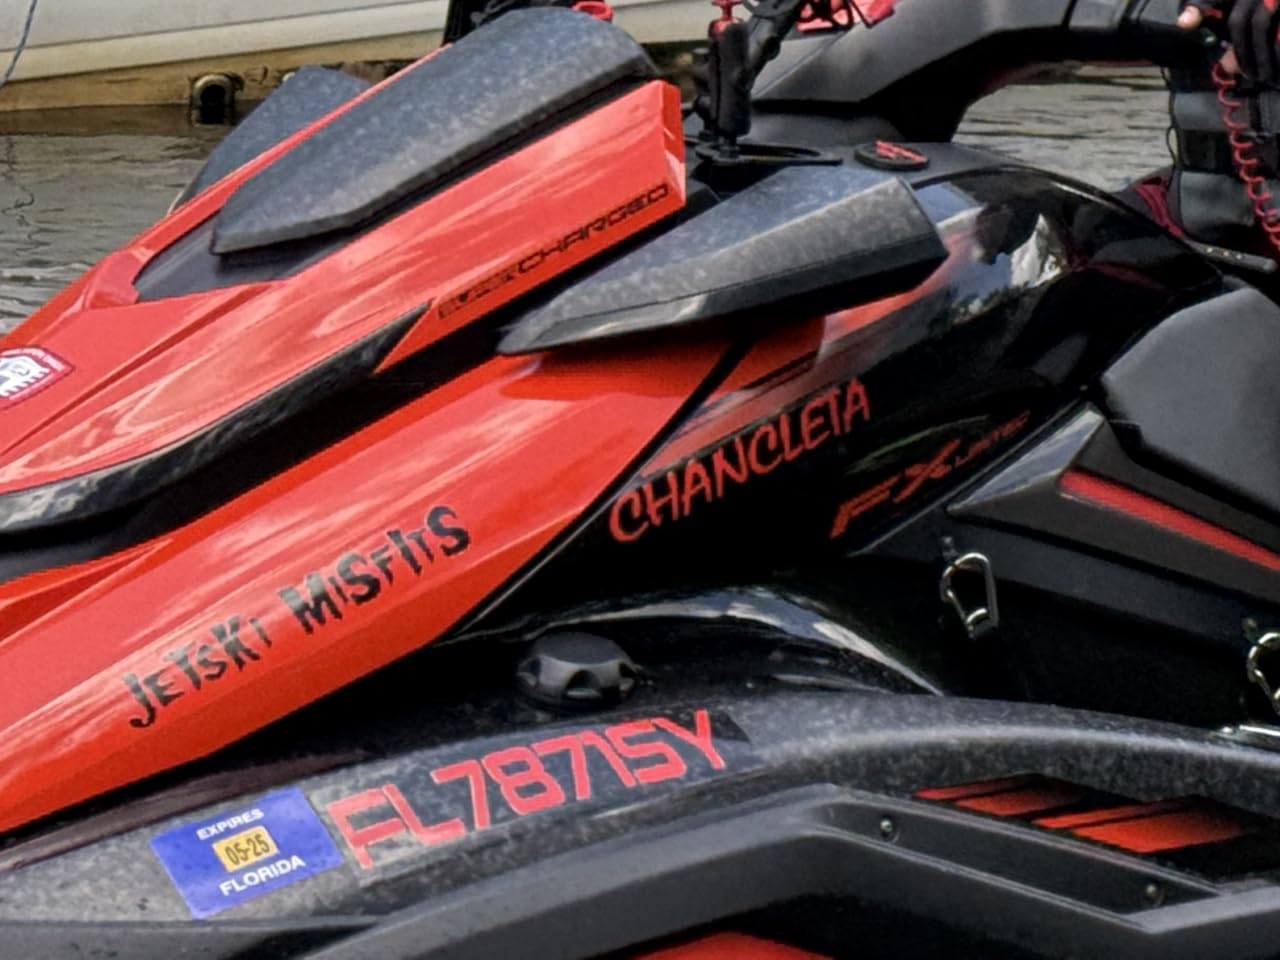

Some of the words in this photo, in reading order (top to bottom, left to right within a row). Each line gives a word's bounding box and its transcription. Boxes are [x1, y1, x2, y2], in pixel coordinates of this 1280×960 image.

[608, 377, 871, 542] CHANCLETA
[829, 439, 961, 539] FX
[196, 808, 264, 841] EXPIRES
[224, 833, 271, 866] 05-25
[219, 855, 307, 896] FLORIDA
